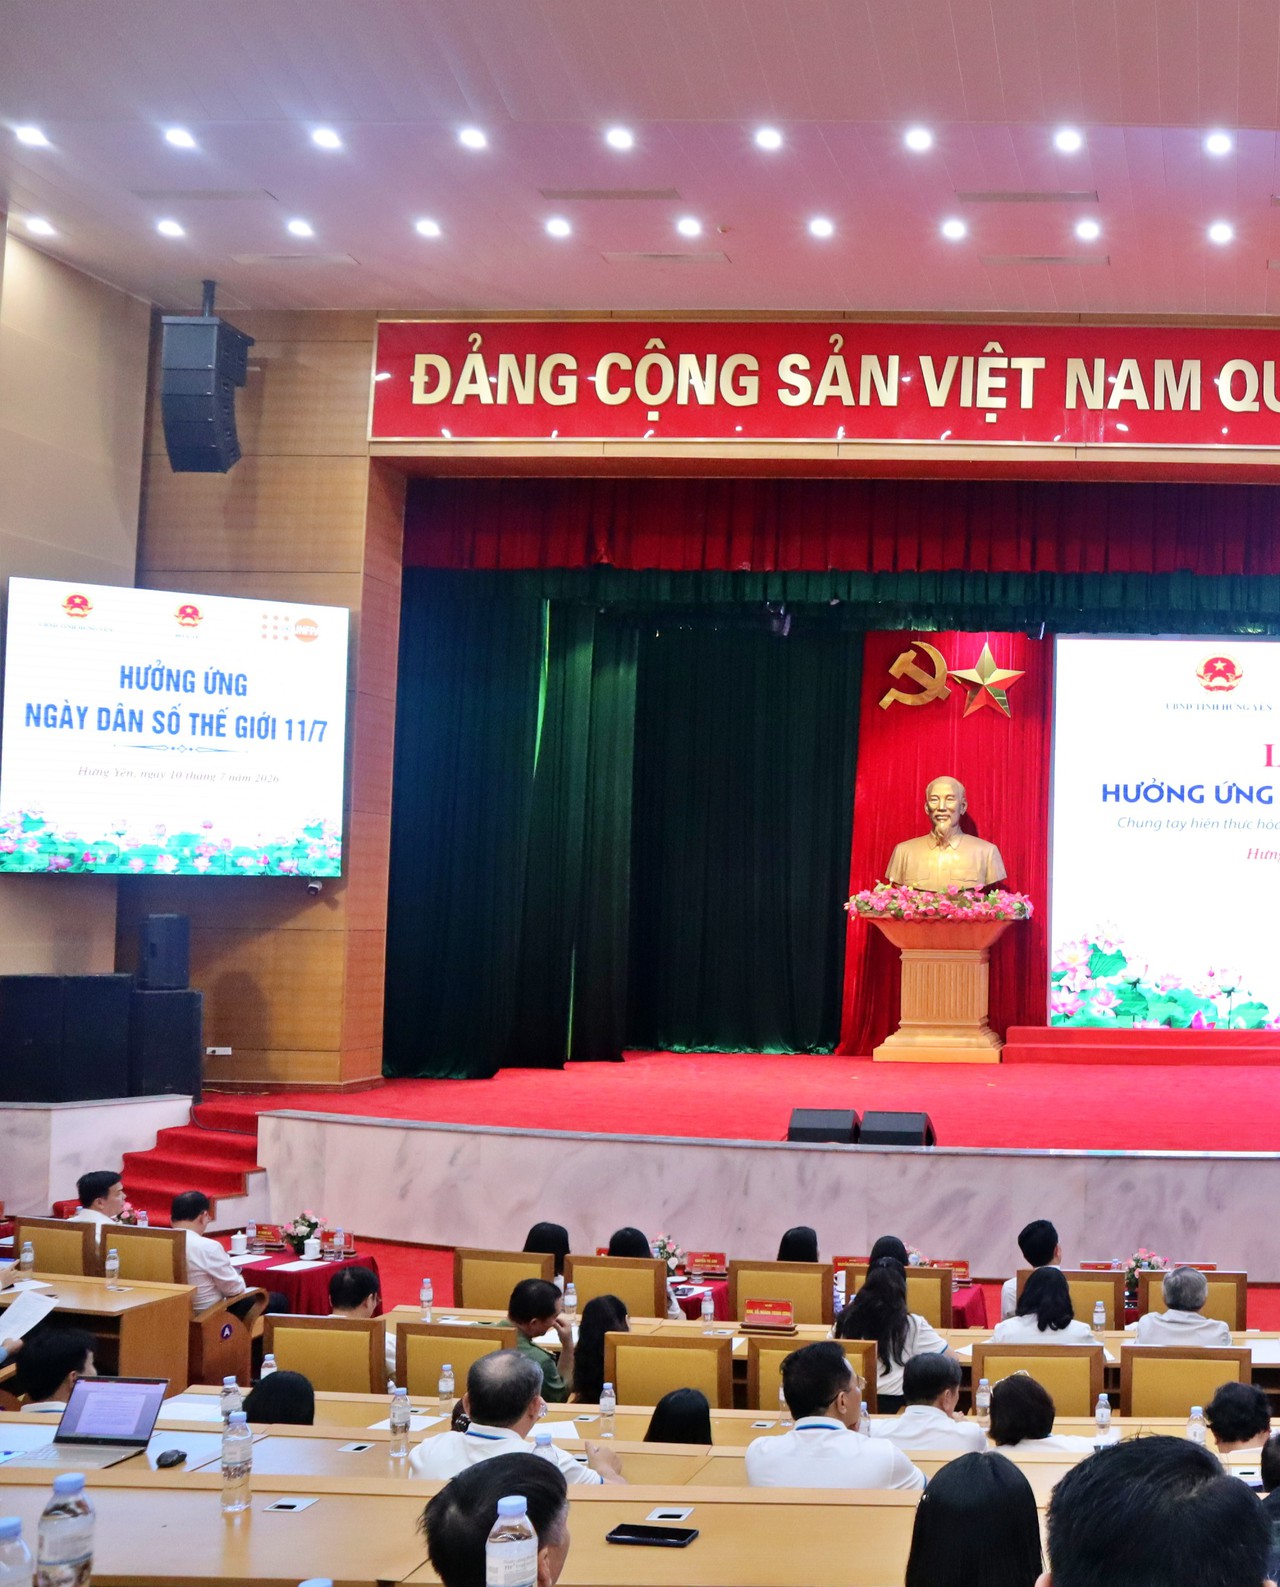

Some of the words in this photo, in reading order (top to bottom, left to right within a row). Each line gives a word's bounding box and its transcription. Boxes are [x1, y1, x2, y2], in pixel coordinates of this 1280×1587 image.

[410, 333, 578, 405] ĐẢNG
[595, 338, 760, 421] CỘNG
[777, 334, 900, 408] SẢN
[918, 341, 1046, 423] VIỆT
[1065, 357, 1201, 411] NAM
[120, 660, 195, 693] HƯỞNG
[204, 667, 247, 696] ỨNG
[25, 699, 88, 730] NGÀY
[97, 703, 143, 733] DÂN
[152, 704, 181, 735] SỐ
[189, 707, 228, 737] THẾ
[235, 712, 276, 740] GIỚI
[285, 719, 327, 742] 11/7
[1102, 778, 1204, 804] HƯỞNG
[1215, 781, 1273, 805] ỨNG
[1118, 817, 1161, 831] Chung
[1166, 818, 1187, 831] tay
[1191, 818, 1219, 830] hiện
[1224, 818, 1252, 830] thực
